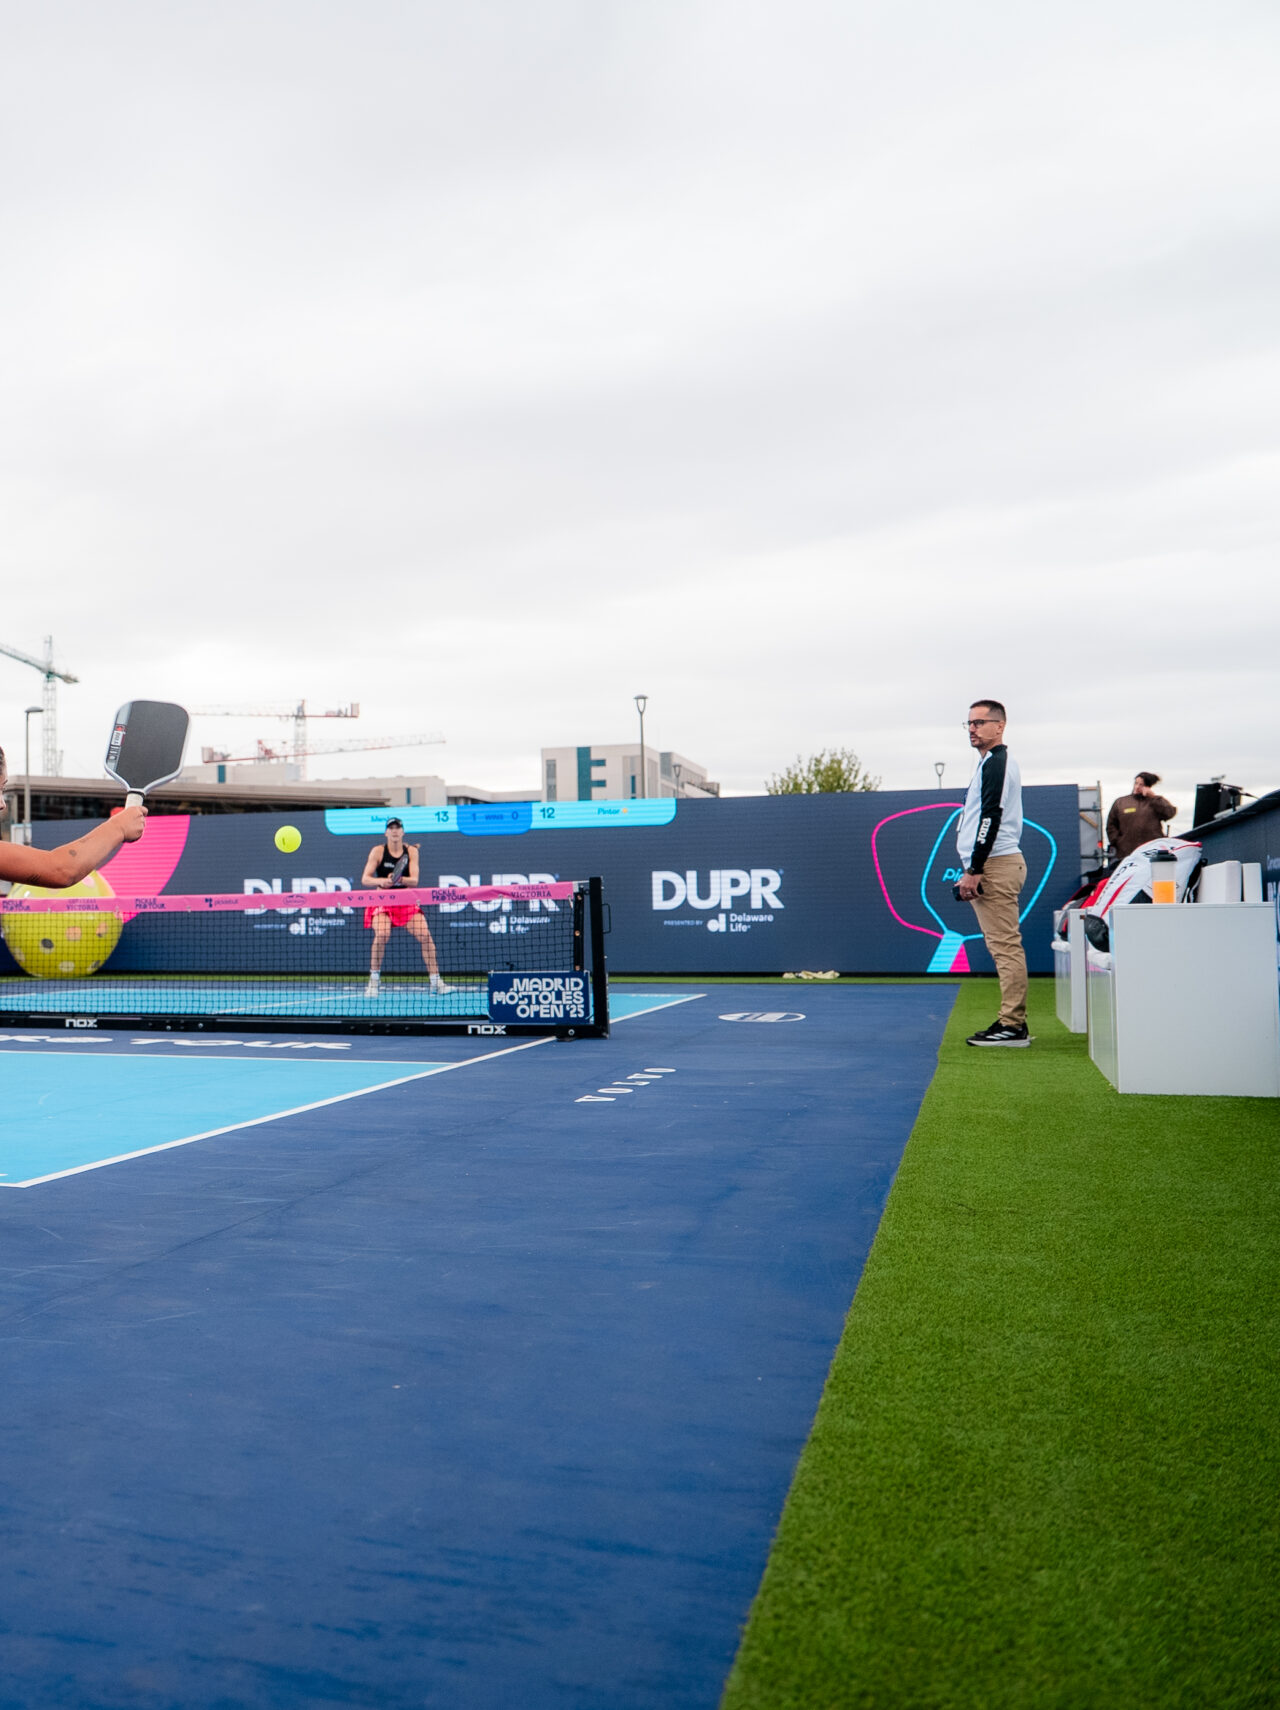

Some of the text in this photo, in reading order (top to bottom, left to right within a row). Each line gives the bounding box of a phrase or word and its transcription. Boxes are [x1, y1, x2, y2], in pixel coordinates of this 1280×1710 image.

[435, 811, 449, 822] 13
[540, 807, 555, 819] 12
[651, 869, 785, 910] DUPR
[729, 913, 774, 922] Delaware
[729, 923, 748, 932] Life
[513, 977, 584, 991] MADRID
[492, 988, 584, 1005] MÓSTOLES
[516, 1004, 564, 1018] OPEN
[128, 1037, 352, 1050] TOUR
